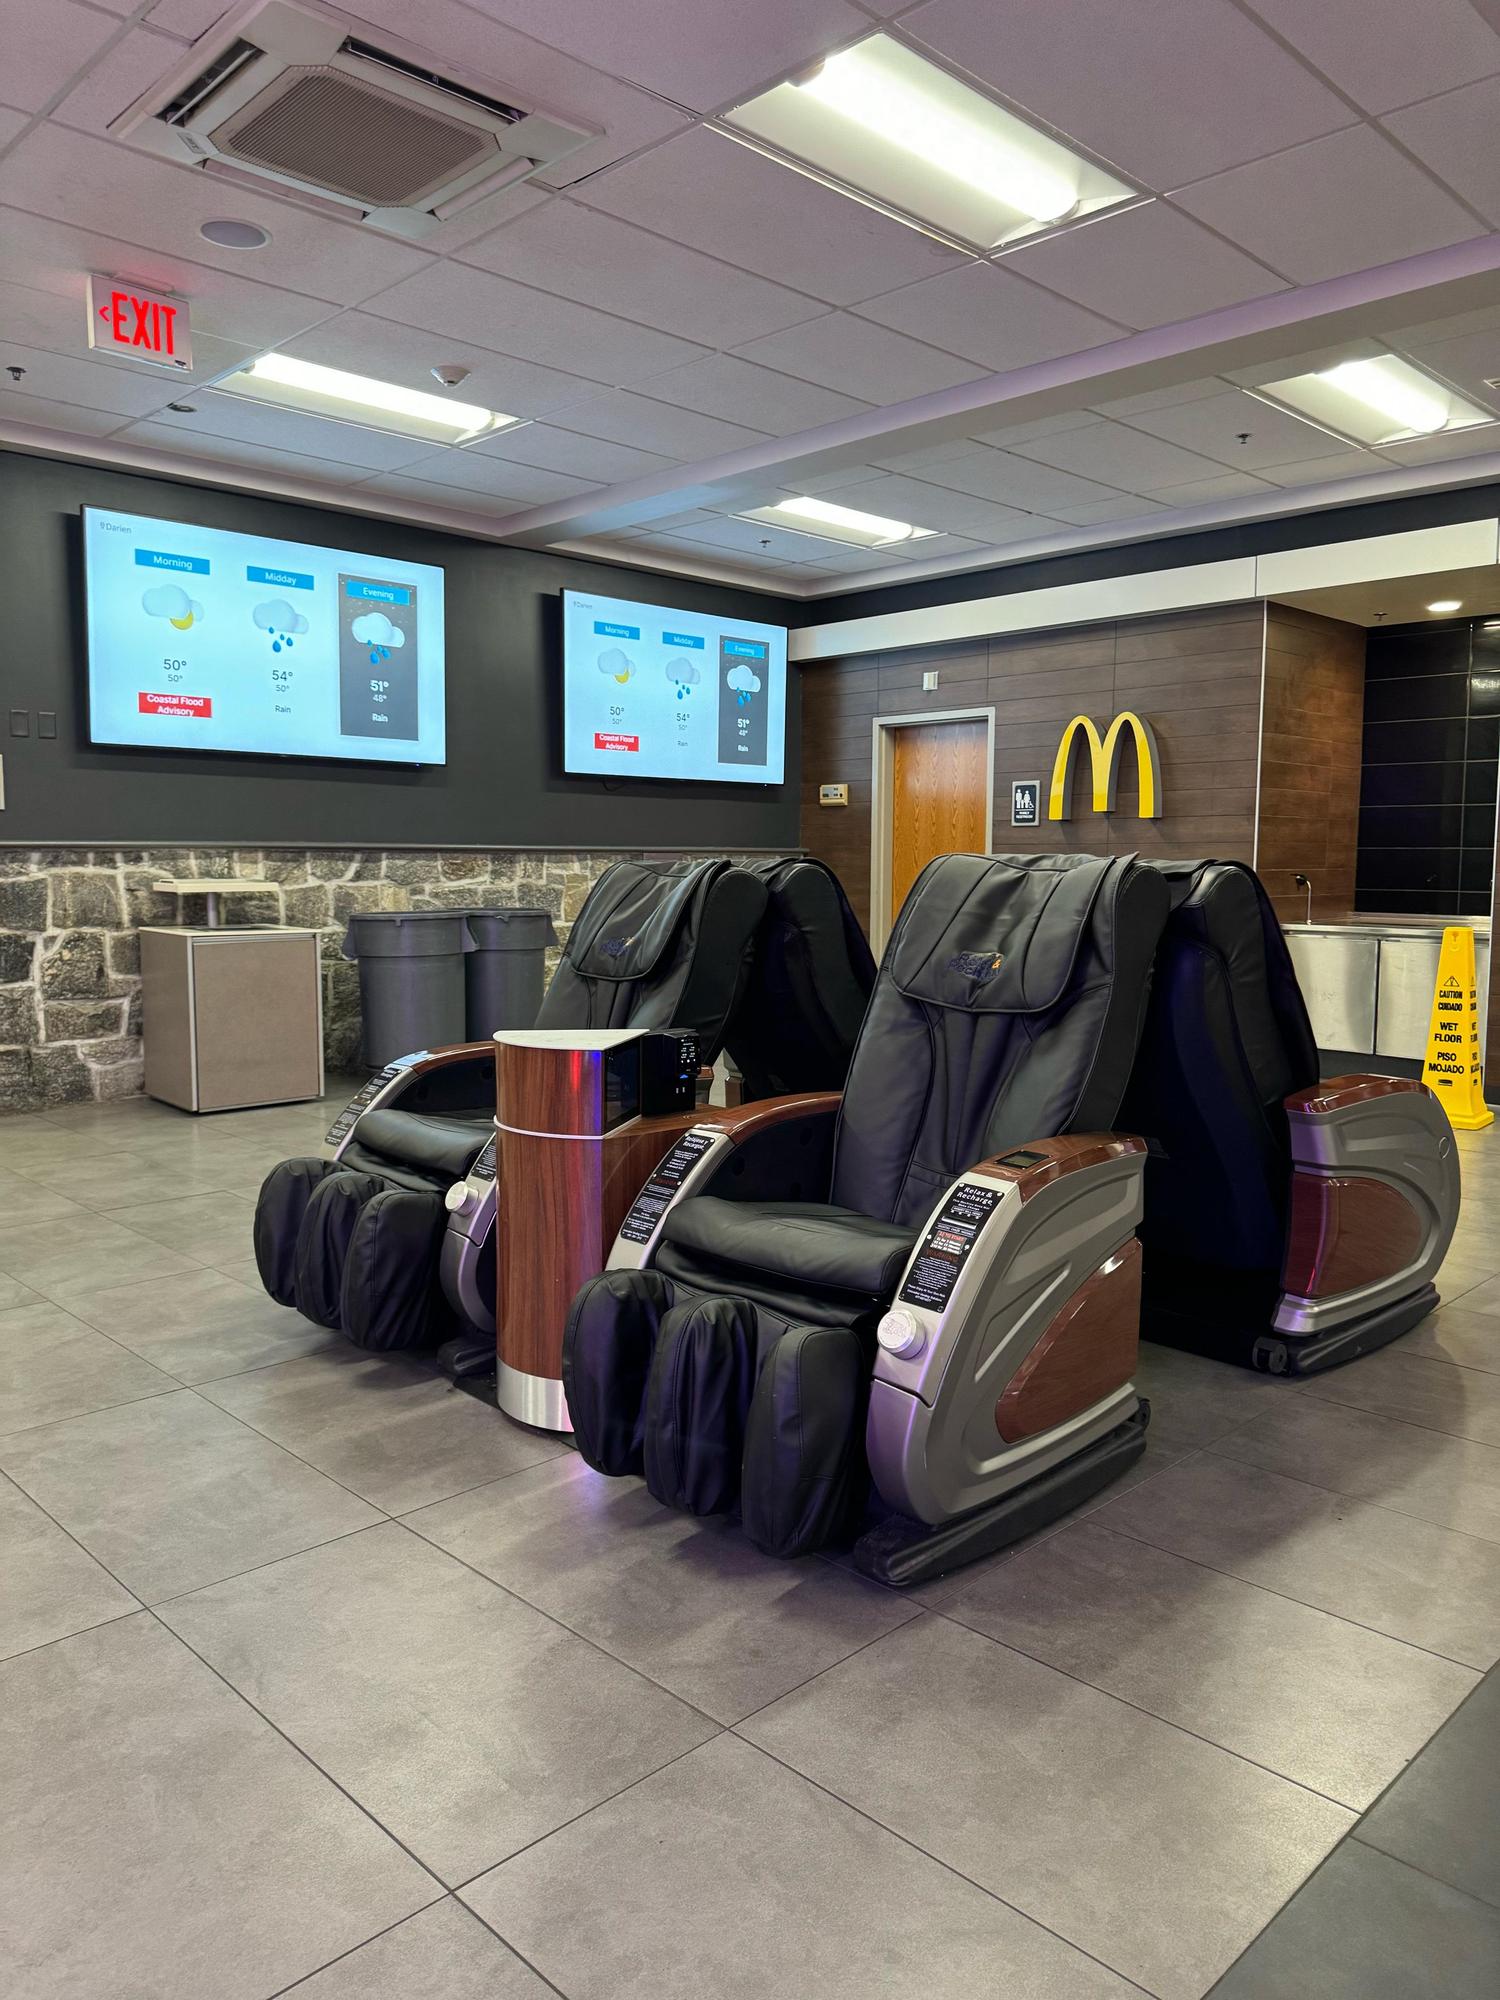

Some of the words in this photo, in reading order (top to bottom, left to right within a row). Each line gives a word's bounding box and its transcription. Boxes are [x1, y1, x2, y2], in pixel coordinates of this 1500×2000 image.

[112, 291, 177, 355] EXIT
[106, 522, 132, 534] Darien
[153, 555, 193, 571] Morning
[265, 571, 297, 586] Midday
[362, 587, 394, 601] Evening
[163, 658, 187, 671] 50°
[272, 669, 293, 681] 54°
[370, 680, 389, 692] 51°
[146, 694, 179, 705] Coastal
[180, 696, 204, 707] Flood
[157, 705, 195, 717] Advisory
[275, 705, 292, 714] Rain
[372, 713, 389, 722] Rain
[1439, 990, 1463, 999] CAUTION
[1438, 1002, 1463, 1011] CUIDADO
[1439, 1022, 1459, 1031] WET
[1434, 1033, 1462, 1043] FLOOR
[1437, 1051, 1457, 1062] PISO
[1428, 1063, 1465, 1074] MOJADO
[964, 1187, 985, 1196] Relax
